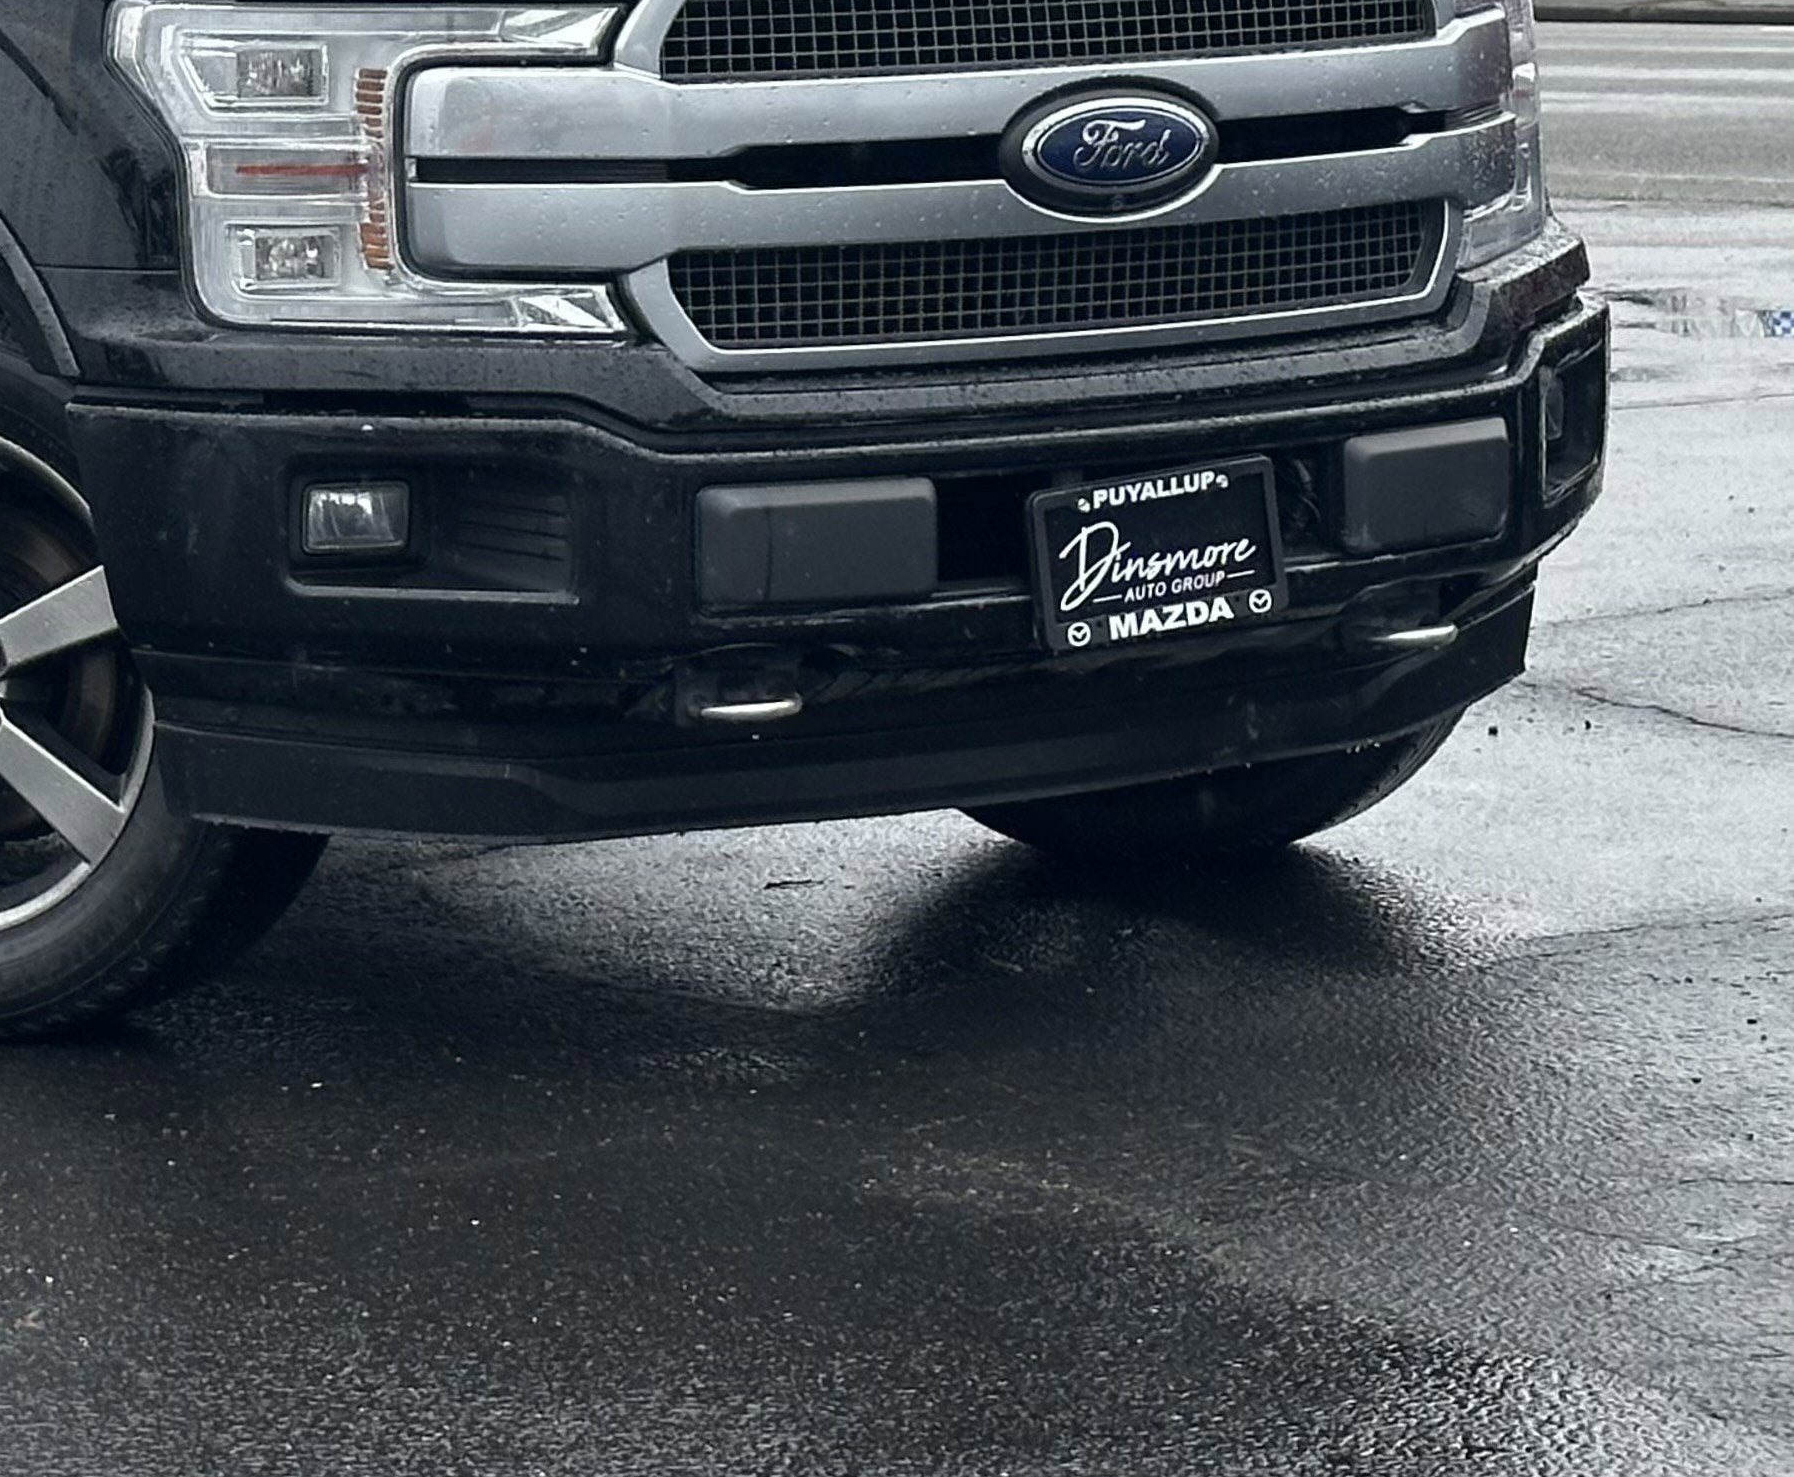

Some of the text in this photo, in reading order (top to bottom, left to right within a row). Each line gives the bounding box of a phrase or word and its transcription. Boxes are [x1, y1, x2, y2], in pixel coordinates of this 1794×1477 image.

[1073, 119, 1172, 169] Ford
[1092, 471, 1216, 509] PUYALLUP
[1058, 520, 1257, 612] Dinsmore
[1124, 570, 1226, 602] AUTO GROUP
[1108, 596, 1235, 641] MAZDA
